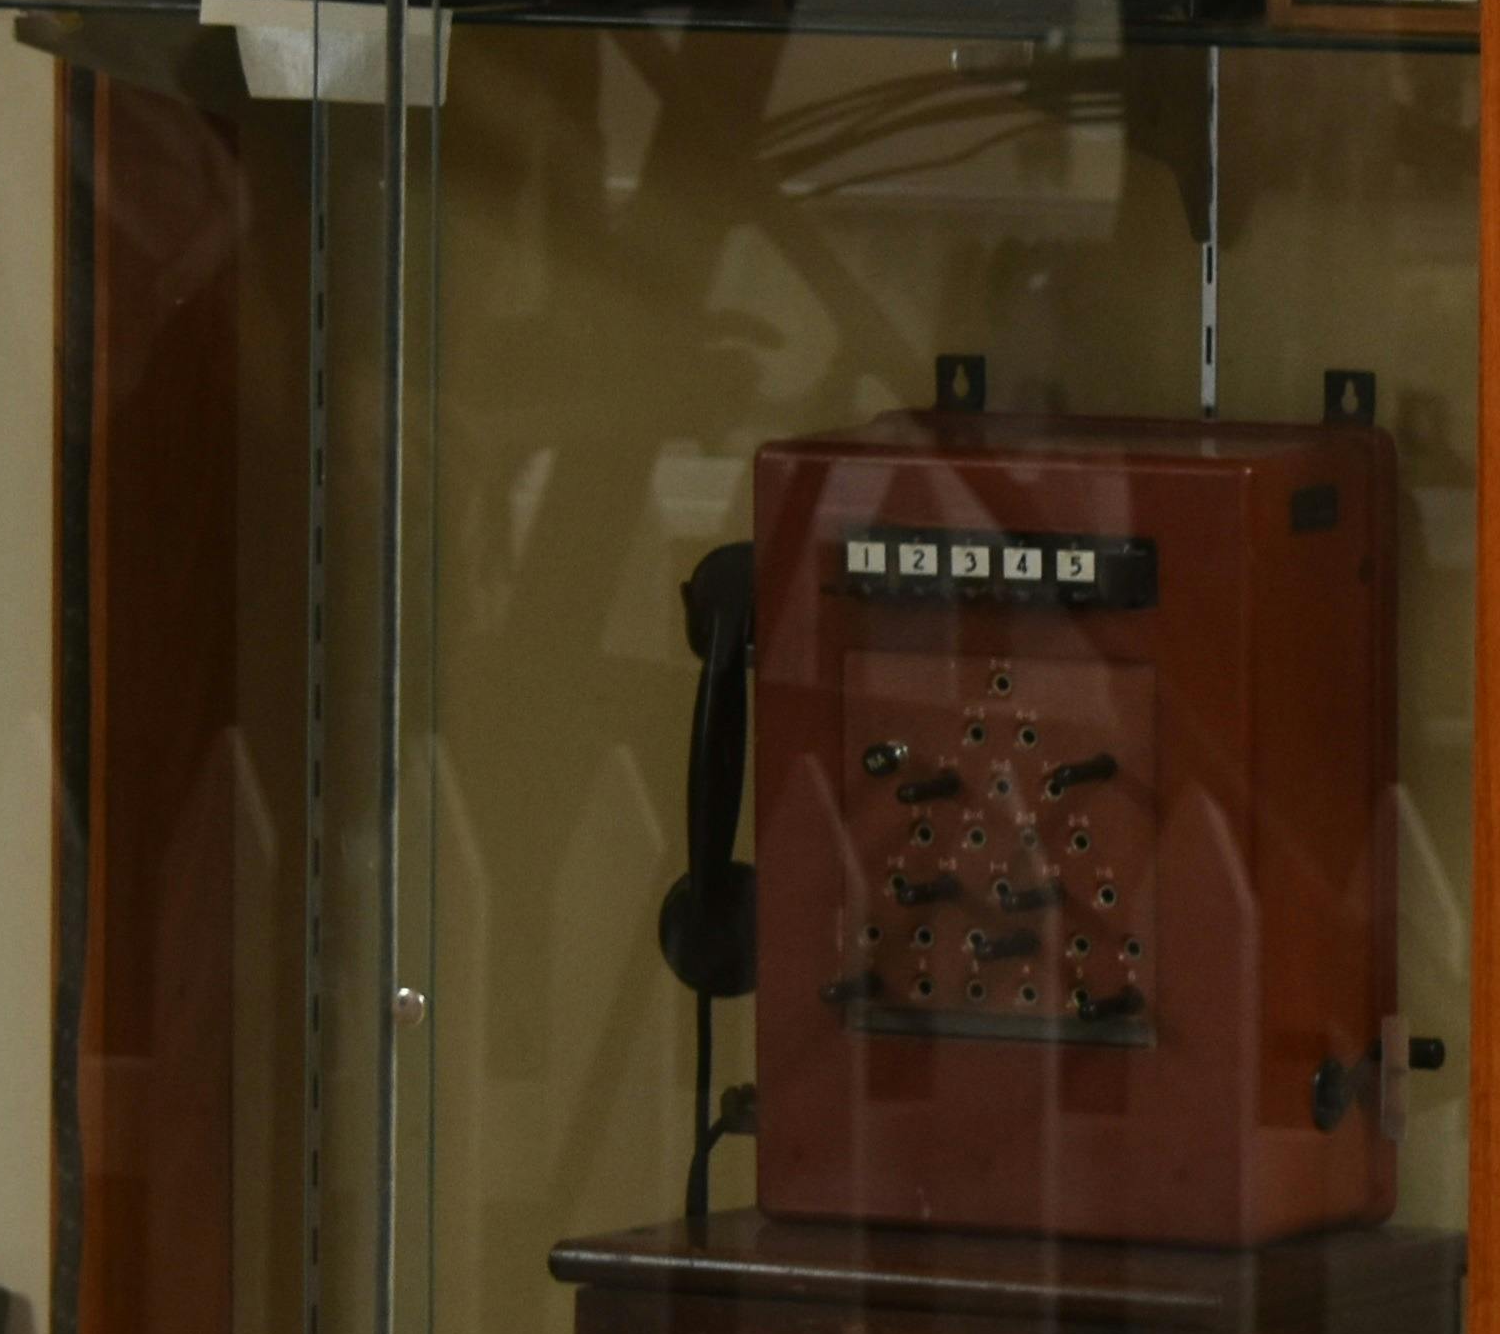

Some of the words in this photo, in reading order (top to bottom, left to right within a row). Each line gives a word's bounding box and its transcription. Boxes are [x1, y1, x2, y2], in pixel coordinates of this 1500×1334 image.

[863, 548, 870, 570] 1
[913, 549, 926, 571] 2
[965, 551, 978, 573] 3
[1016, 552, 1028, 575] 4
[1070, 554, 1082, 577] 5
